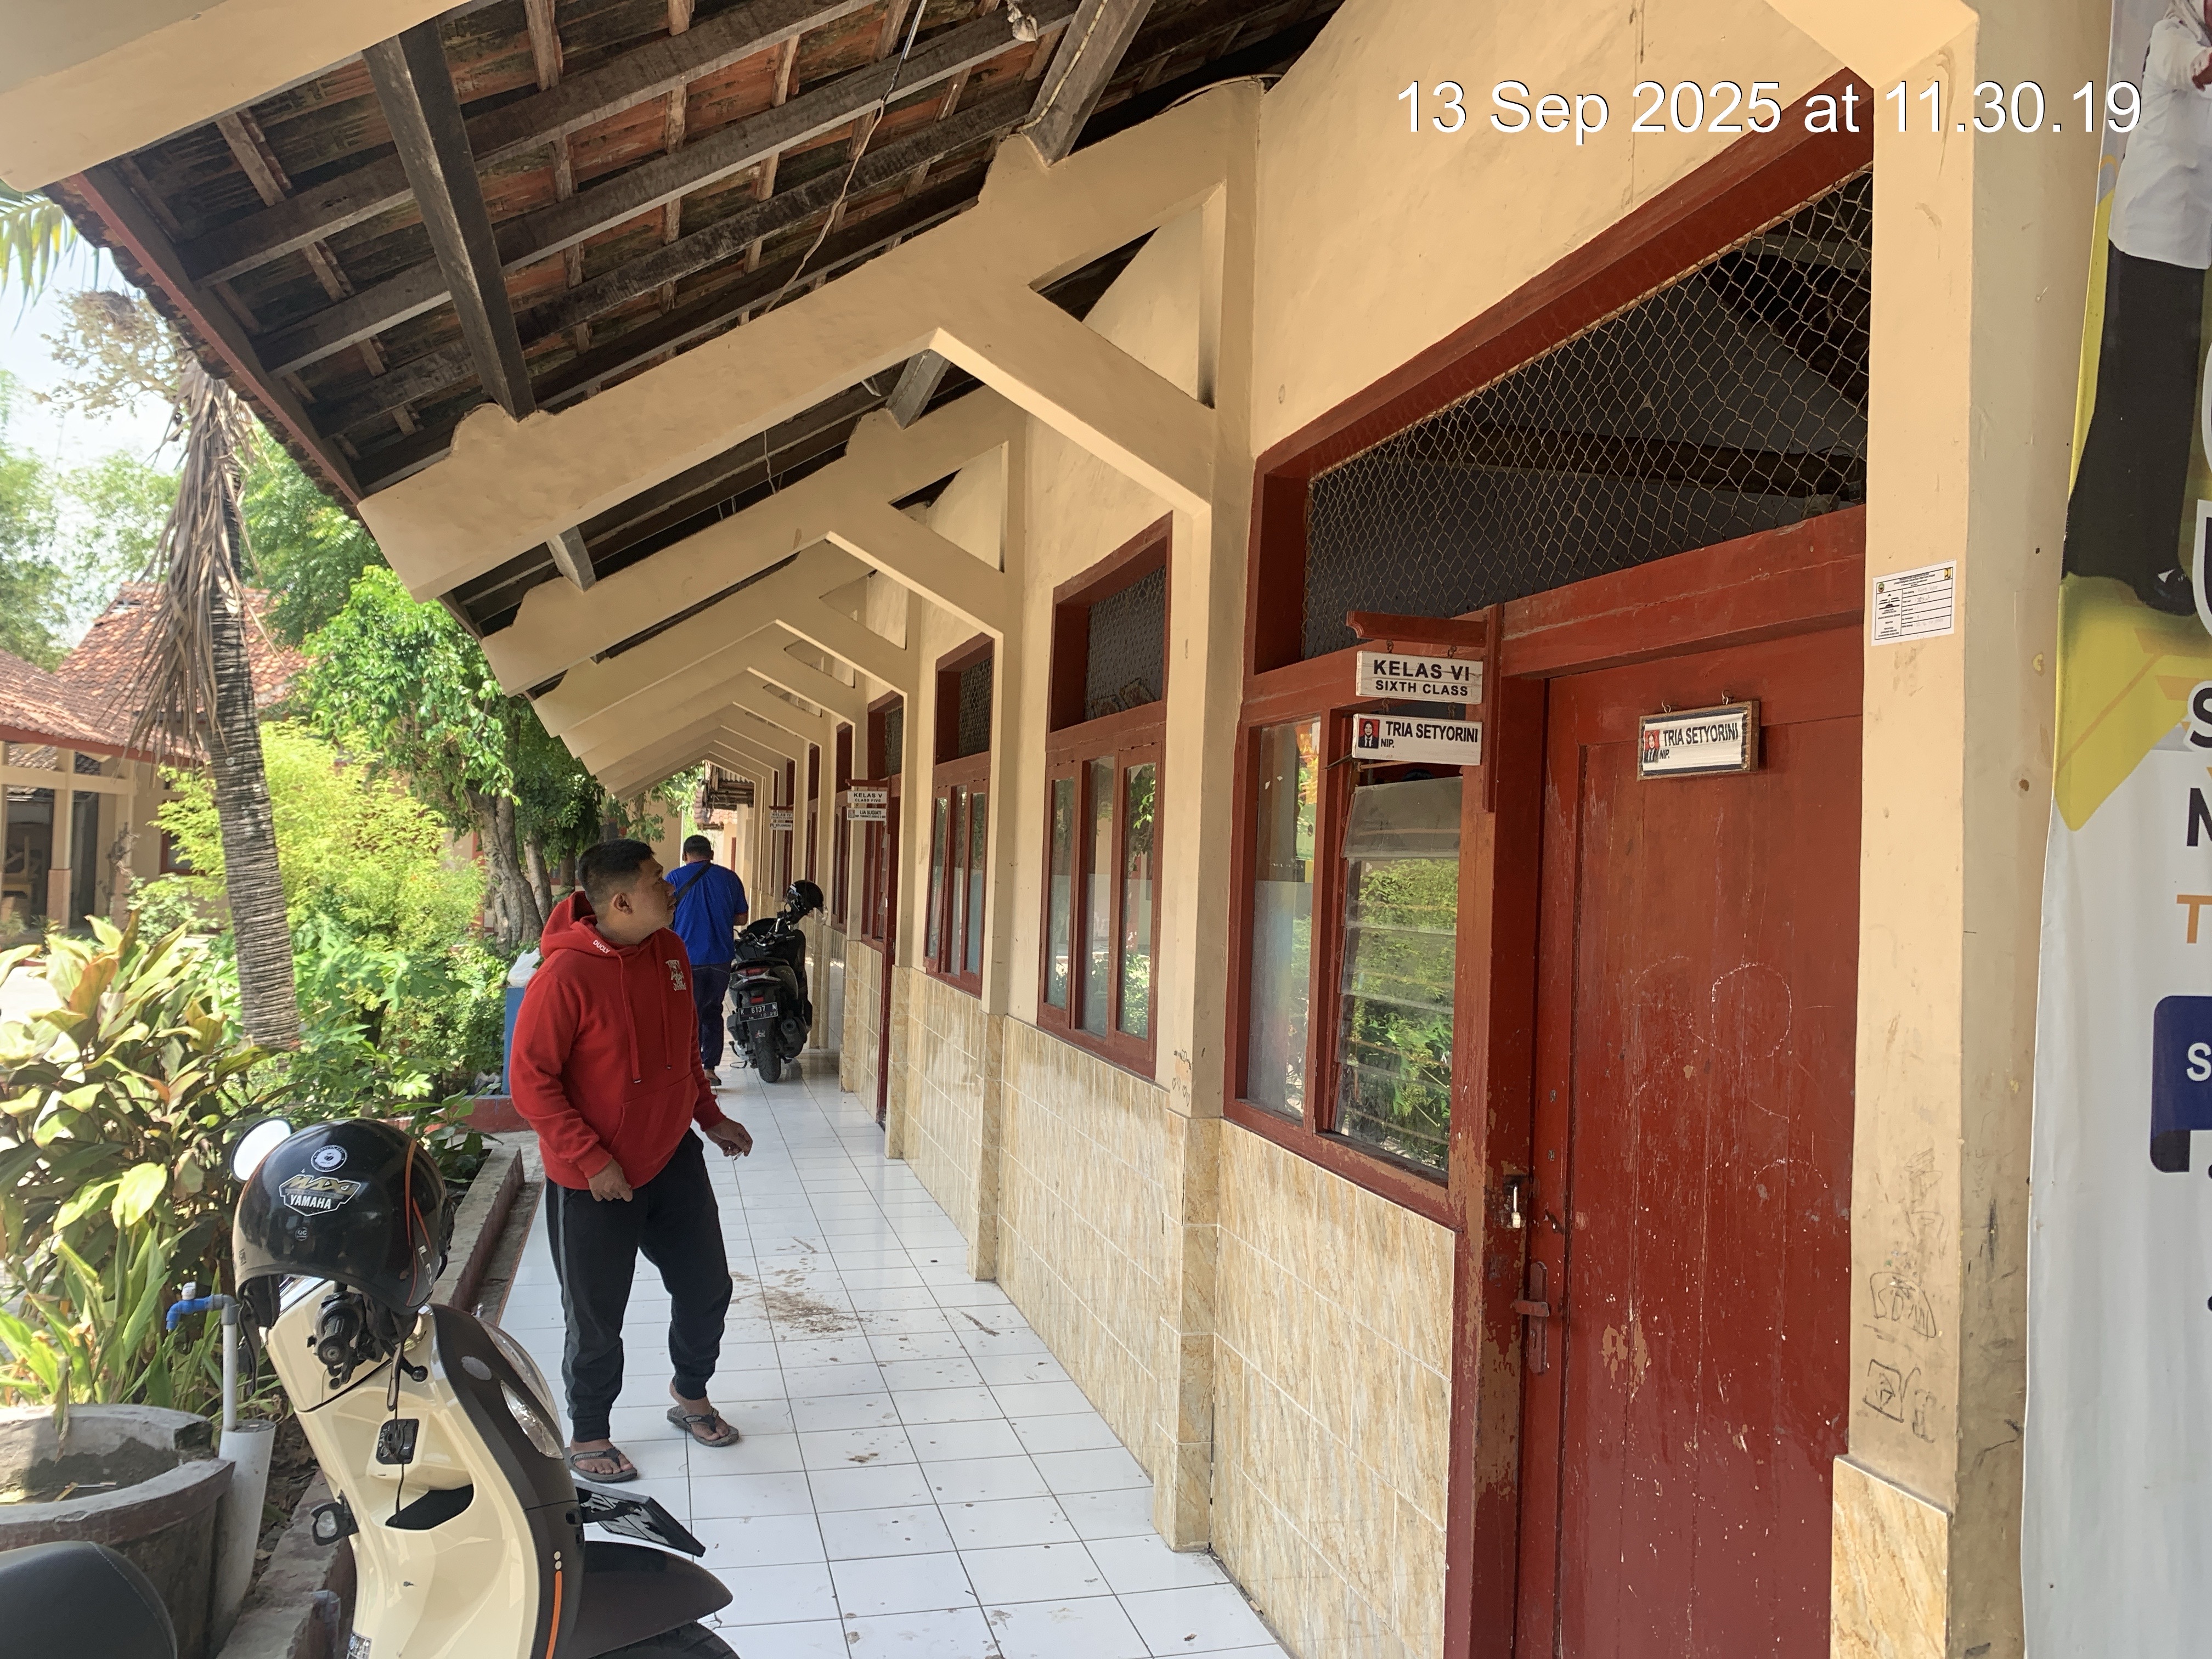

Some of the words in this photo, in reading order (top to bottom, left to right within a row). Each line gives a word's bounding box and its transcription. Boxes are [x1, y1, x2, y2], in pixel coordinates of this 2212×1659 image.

[1373, 659, 1442, 679] KELAS
[1451, 665, 1470, 681] VI
[1375, 680, 1417, 693] SIXTH
[1422, 683, 1468, 696] CLASS
[1386, 721, 1413, 737] TRIA
[1415, 723, 1479, 743] SETYORINI
[1662, 728, 1684, 747] TRIA
[1685, 723, 1739, 745] SETYORINI
[1380, 738, 1395, 748] NIP.
[1659, 749, 1670, 759] NIP.
[751, 1005, 766, 1014] 6137
[290, 1194, 332, 1210] YAMAHA
